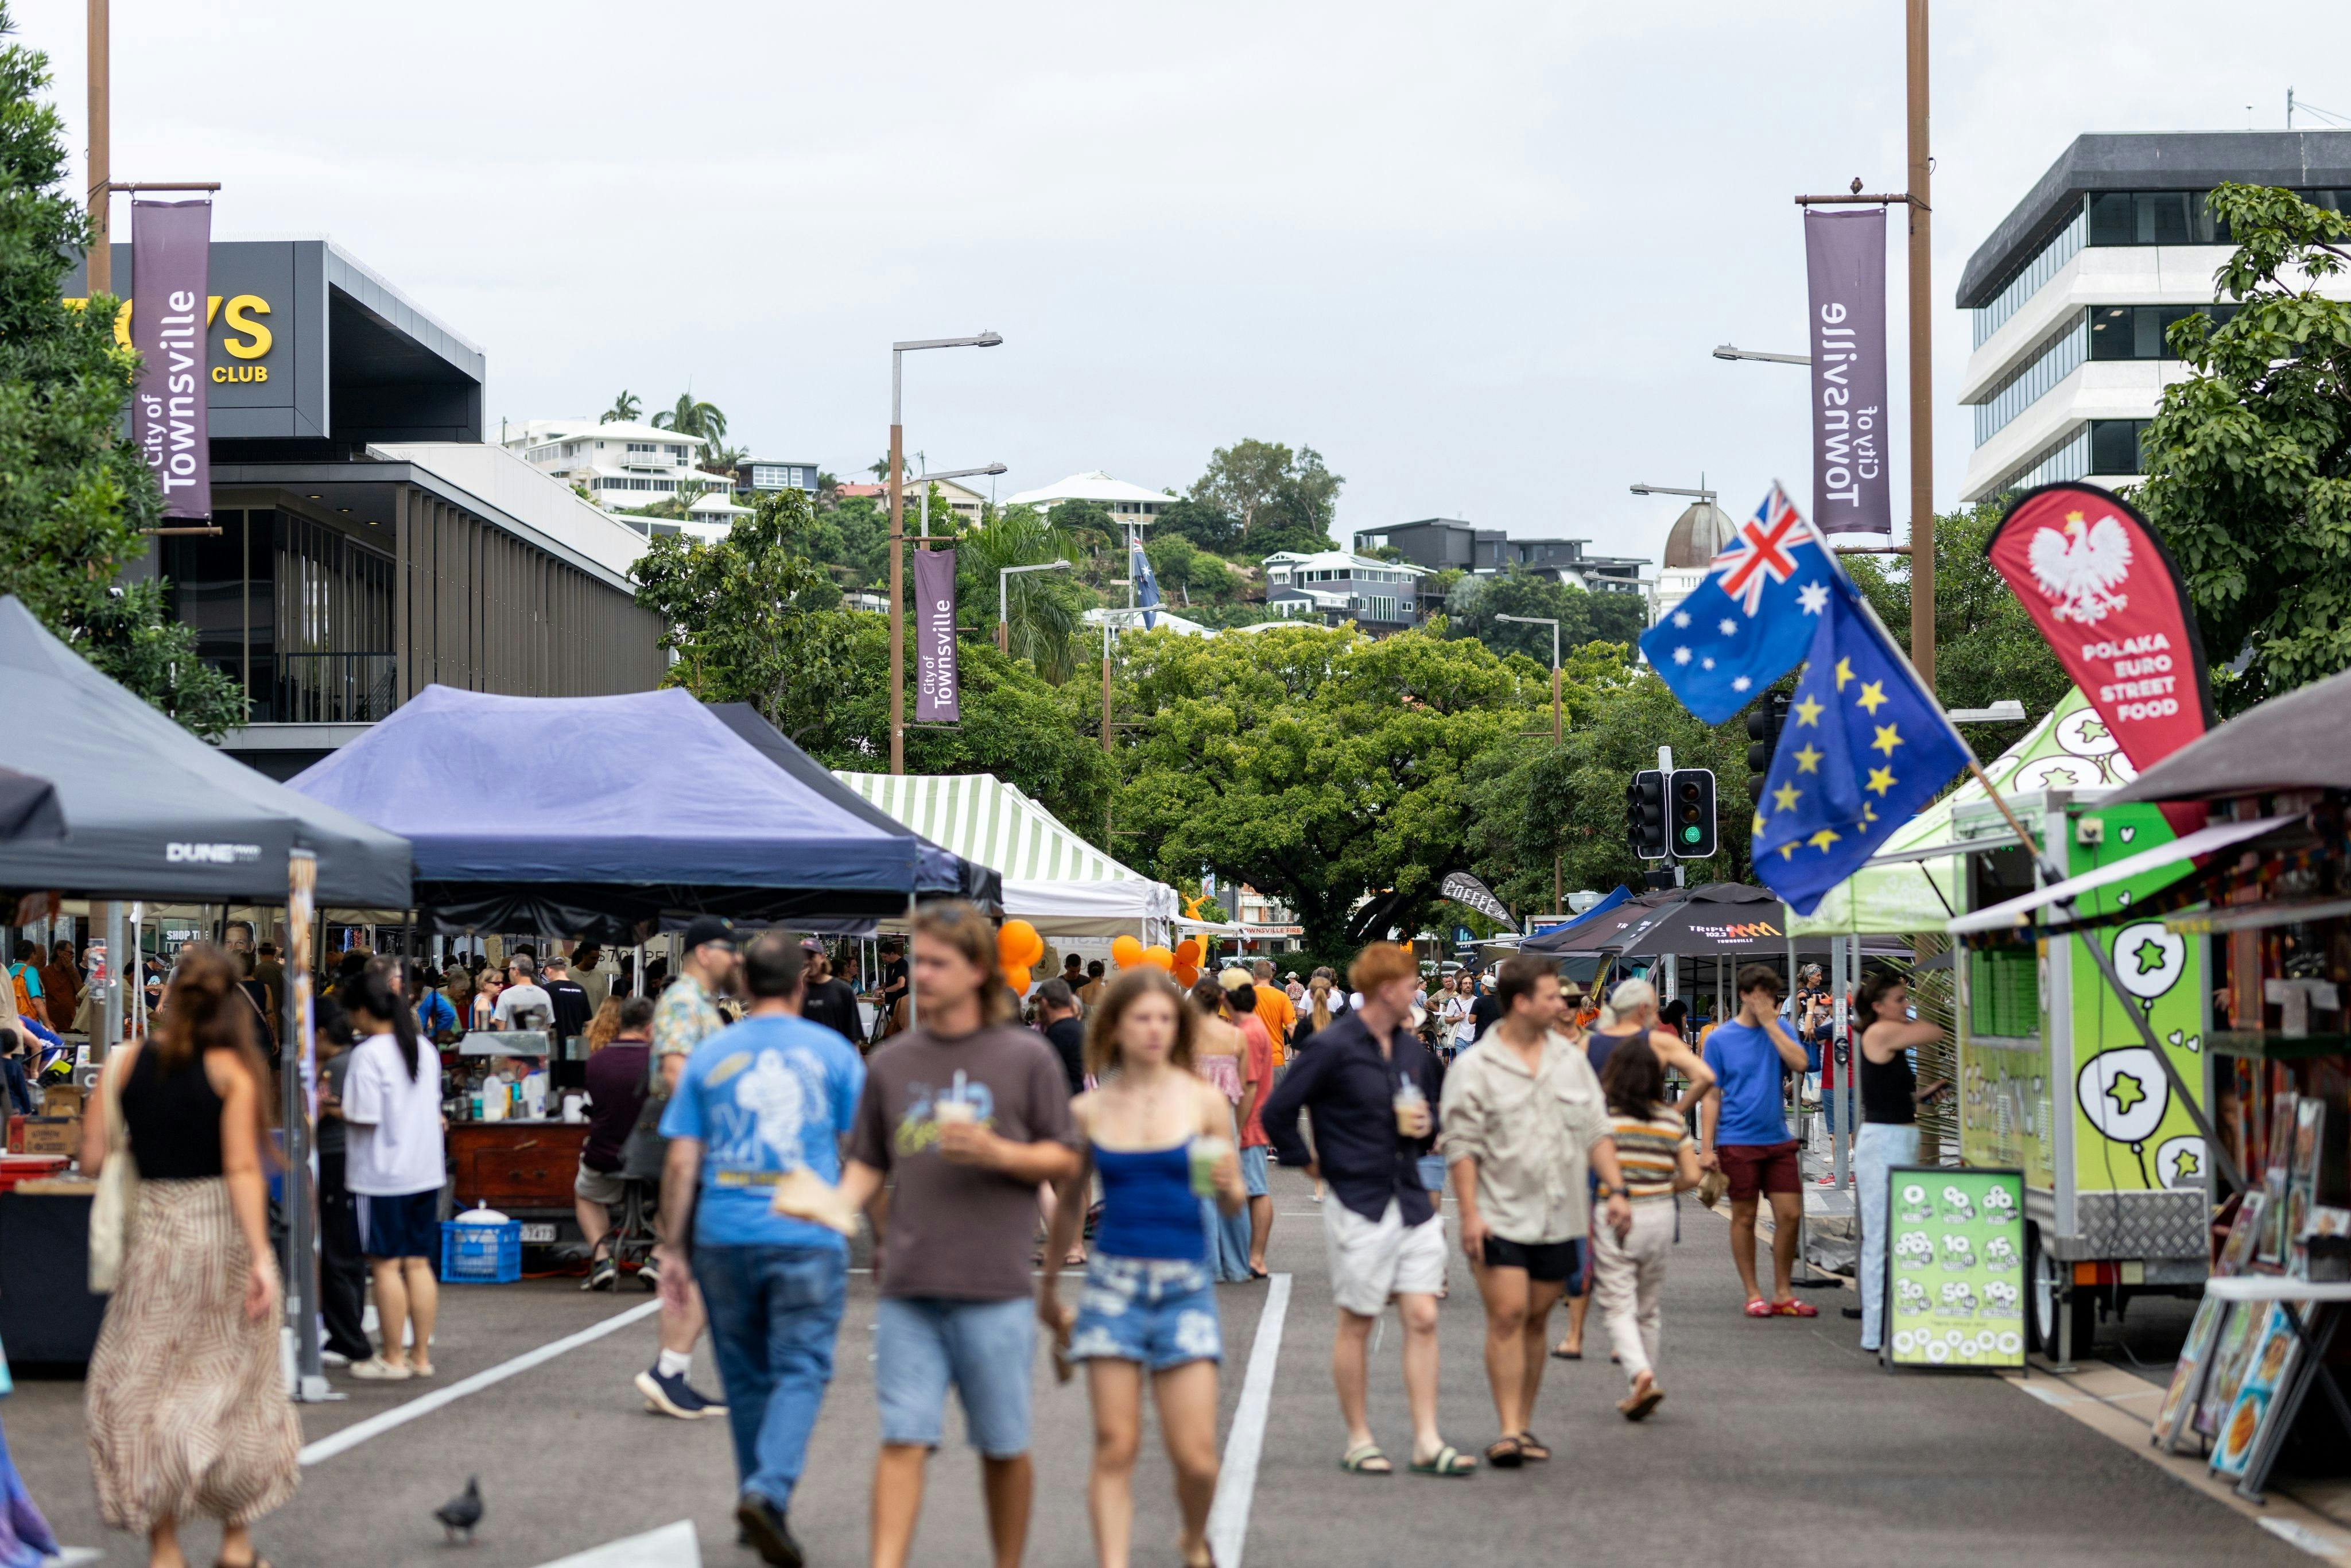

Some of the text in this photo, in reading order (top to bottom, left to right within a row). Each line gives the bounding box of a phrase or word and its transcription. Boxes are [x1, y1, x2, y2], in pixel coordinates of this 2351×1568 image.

[212, 366, 268, 383] CLUB
[160, 290, 196, 494] Townsville
[141, 394, 167, 466] City of
[932, 600, 952, 709] Townsville
[2082, 632, 2171, 662] POLAKA
[923, 655, 937, 694] City of
[2113, 654, 2172, 678] EURO
[2100, 675, 2176, 703] STREET
[2117, 697, 2179, 723] FOOD
[1444, 880, 1496, 914] COFFEE
[166, 930, 191, 940] SHOP
[1688, 925, 1733, 933] TRIPLE
